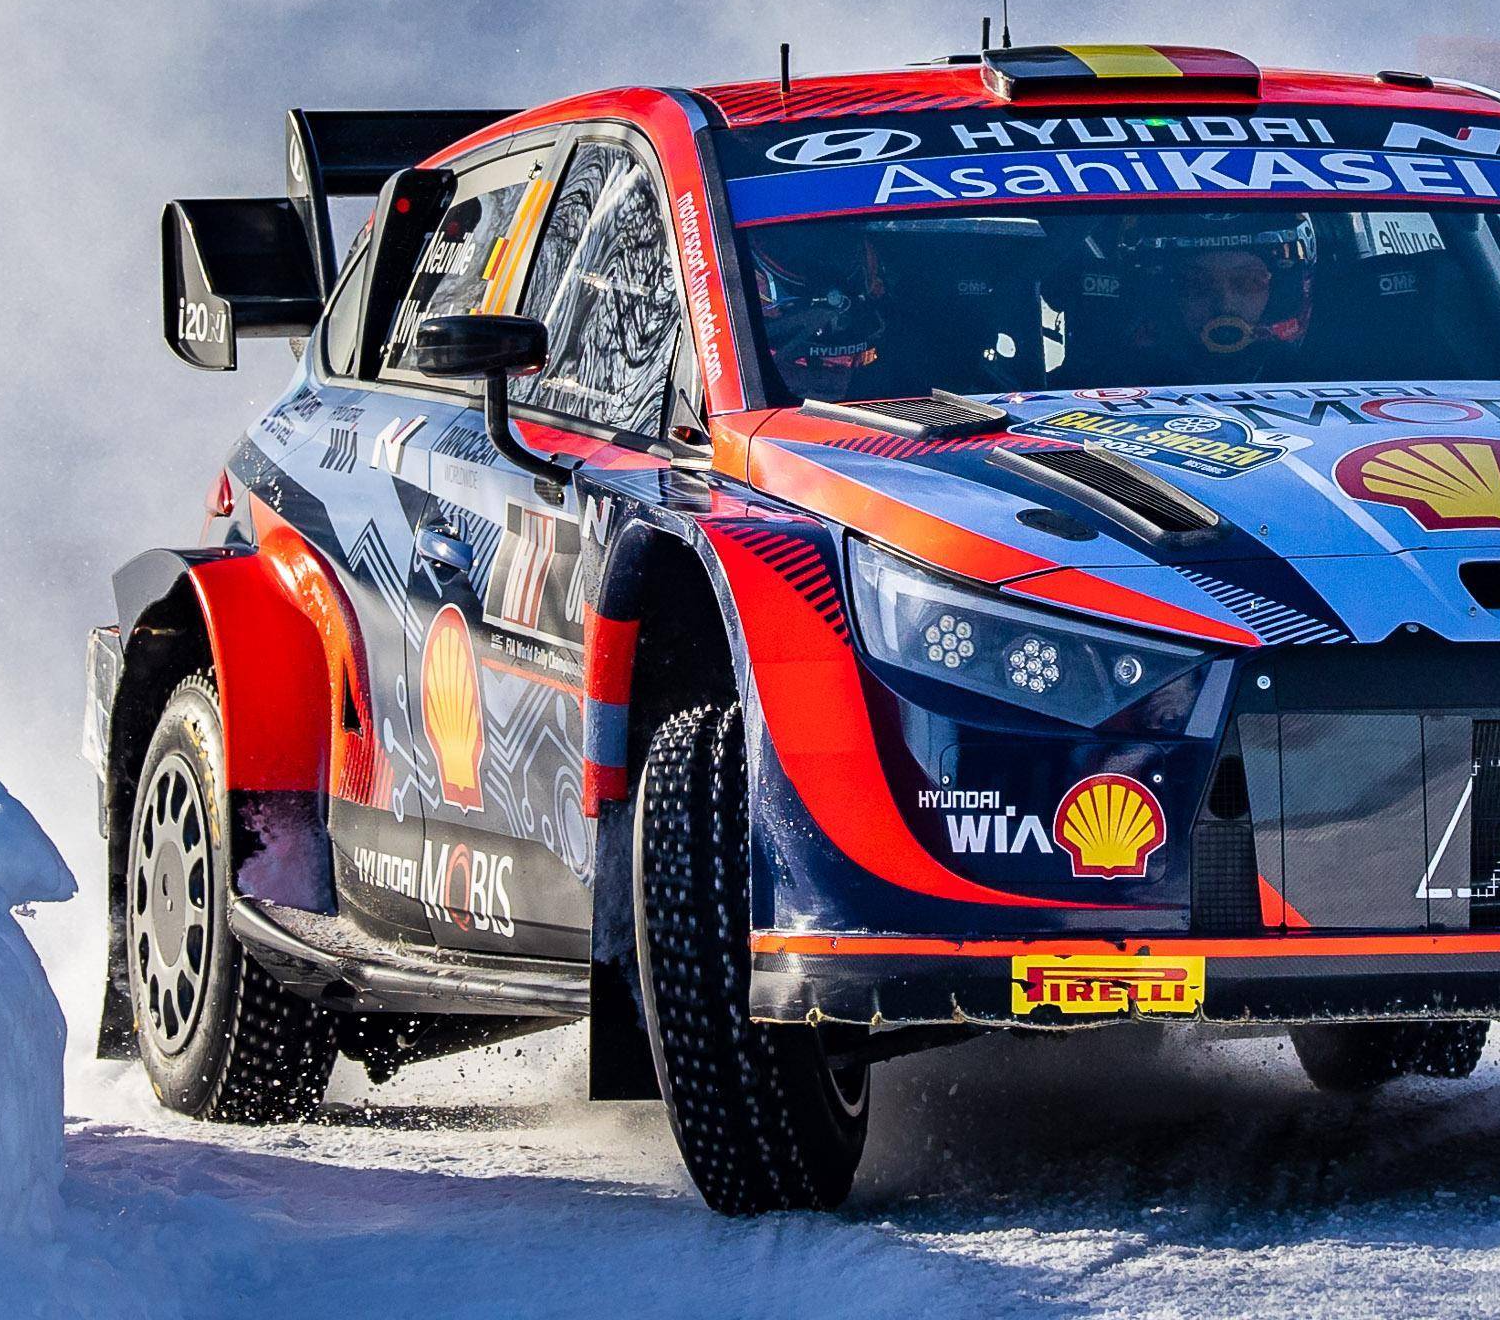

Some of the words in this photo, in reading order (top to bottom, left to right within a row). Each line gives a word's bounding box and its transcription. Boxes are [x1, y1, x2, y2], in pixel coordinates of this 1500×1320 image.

[950, 116, 1335, 149] HYUNDAI
[676, 191, 723, 385] motorsport.hyundai.com
[178, 297, 209, 342] i20
[810, 341, 868, 356] HYUNDAI
[1100, 386, 1438, 412] HYUNDAI
[434, 425, 500, 467] INNOCEAN
[1045, 411, 1150, 436] RALLY
[1135, 430, 1275, 466] SWEDEN
[1093, 438, 1158, 457] 2022
[918, 790, 1000, 809] HYUNDAI
[946, 806, 1054, 854] WIA
[354, 846, 418, 899] HYUNDAI
[419, 839, 515, 938] MOBIS
[1026, 967, 1188, 1002] PIRELLI
